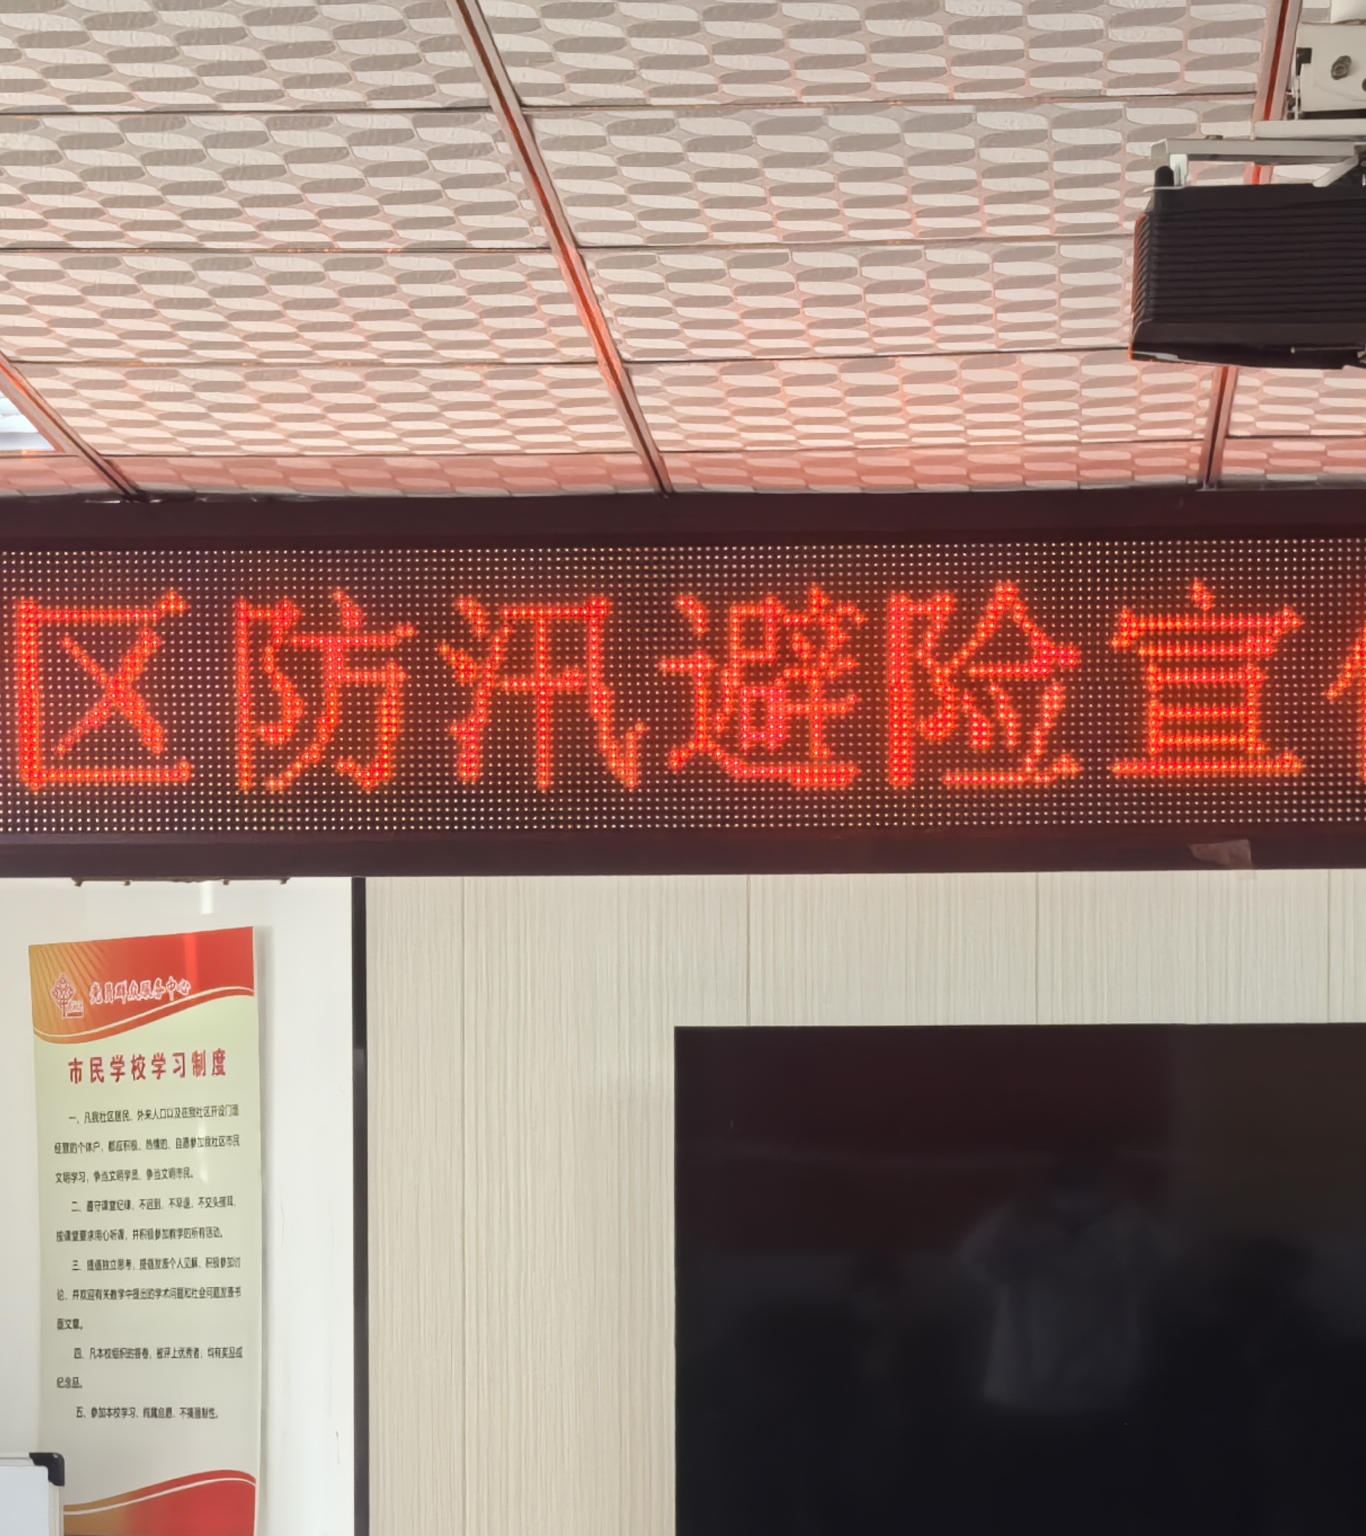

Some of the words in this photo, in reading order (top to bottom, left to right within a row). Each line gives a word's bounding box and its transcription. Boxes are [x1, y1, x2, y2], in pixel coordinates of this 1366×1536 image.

[68, 1048, 227, 1085] 市民学校学习制度
